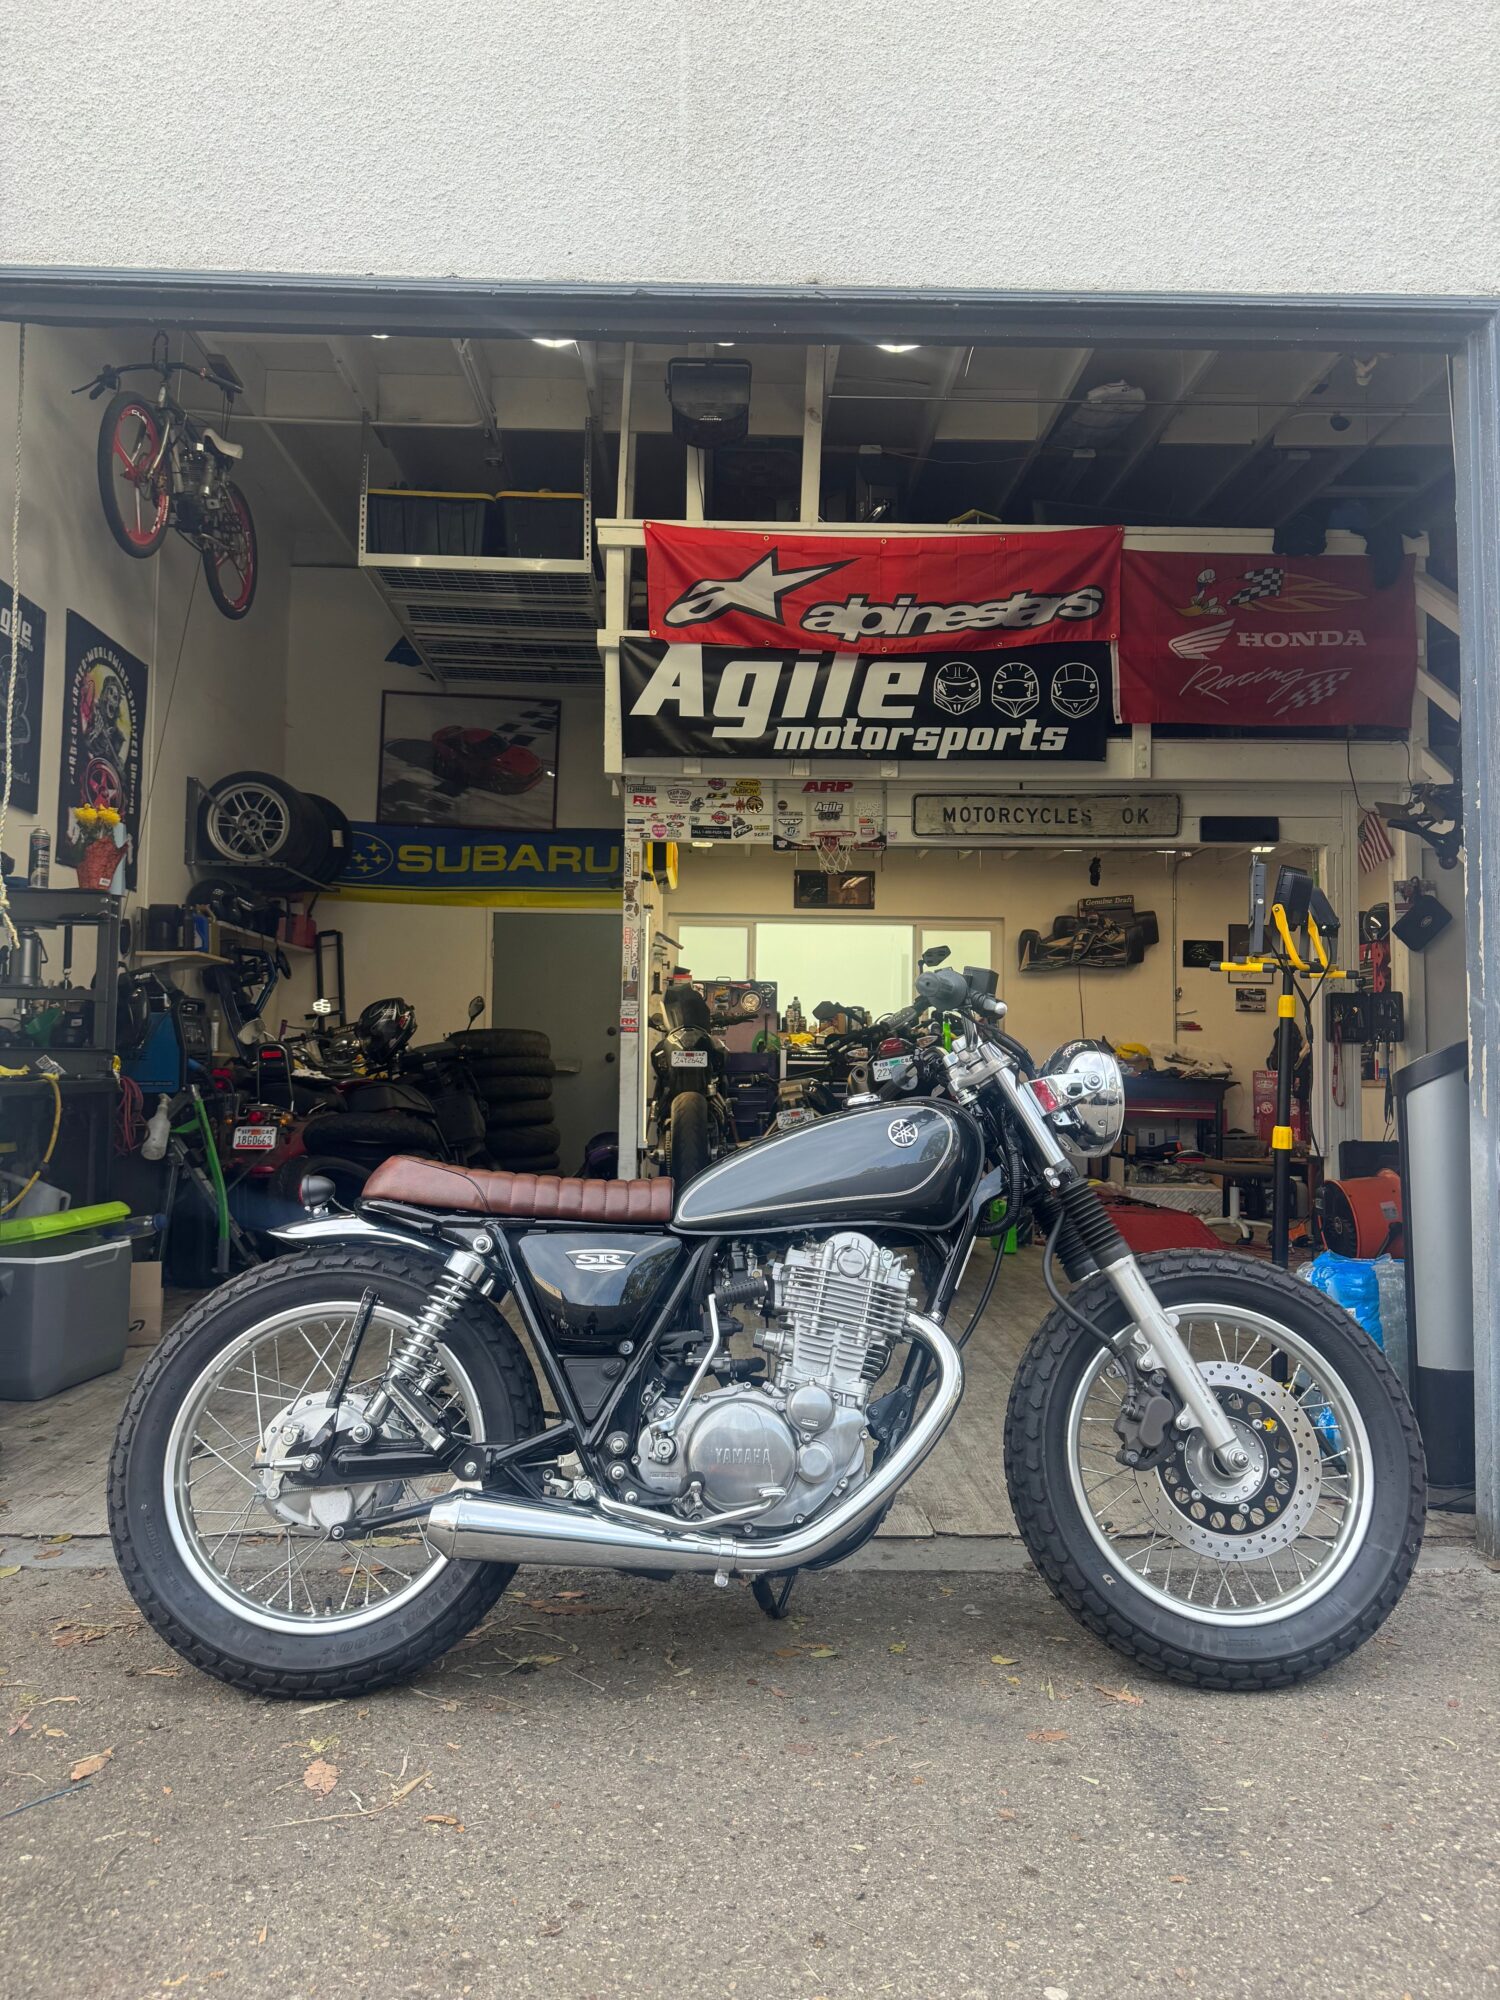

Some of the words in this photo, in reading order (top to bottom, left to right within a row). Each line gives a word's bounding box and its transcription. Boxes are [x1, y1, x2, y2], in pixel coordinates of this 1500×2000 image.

[802, 587, 1103, 641] alpinestars
[1236, 629, 1367, 648] HONDA
[630, 643, 927, 738] Agile
[1179, 664, 1352, 704] Racing
[773, 718, 1069, 760] motorsports
[802, 782, 854, 793] ARP
[633, 795, 657, 806] RK
[815, 802, 844, 813] Agile
[943, 806, 1093, 824] MOTORCYCLES
[1121, 806, 1151, 824] OK
[397, 844, 620, 873] SUBARU
[1114, 897, 1133, 905] Draft
[621, 1018, 638, 1026] RK
[576, 1254, 627, 1265] SR
[715, 1448, 770, 1464] YAMAHA
